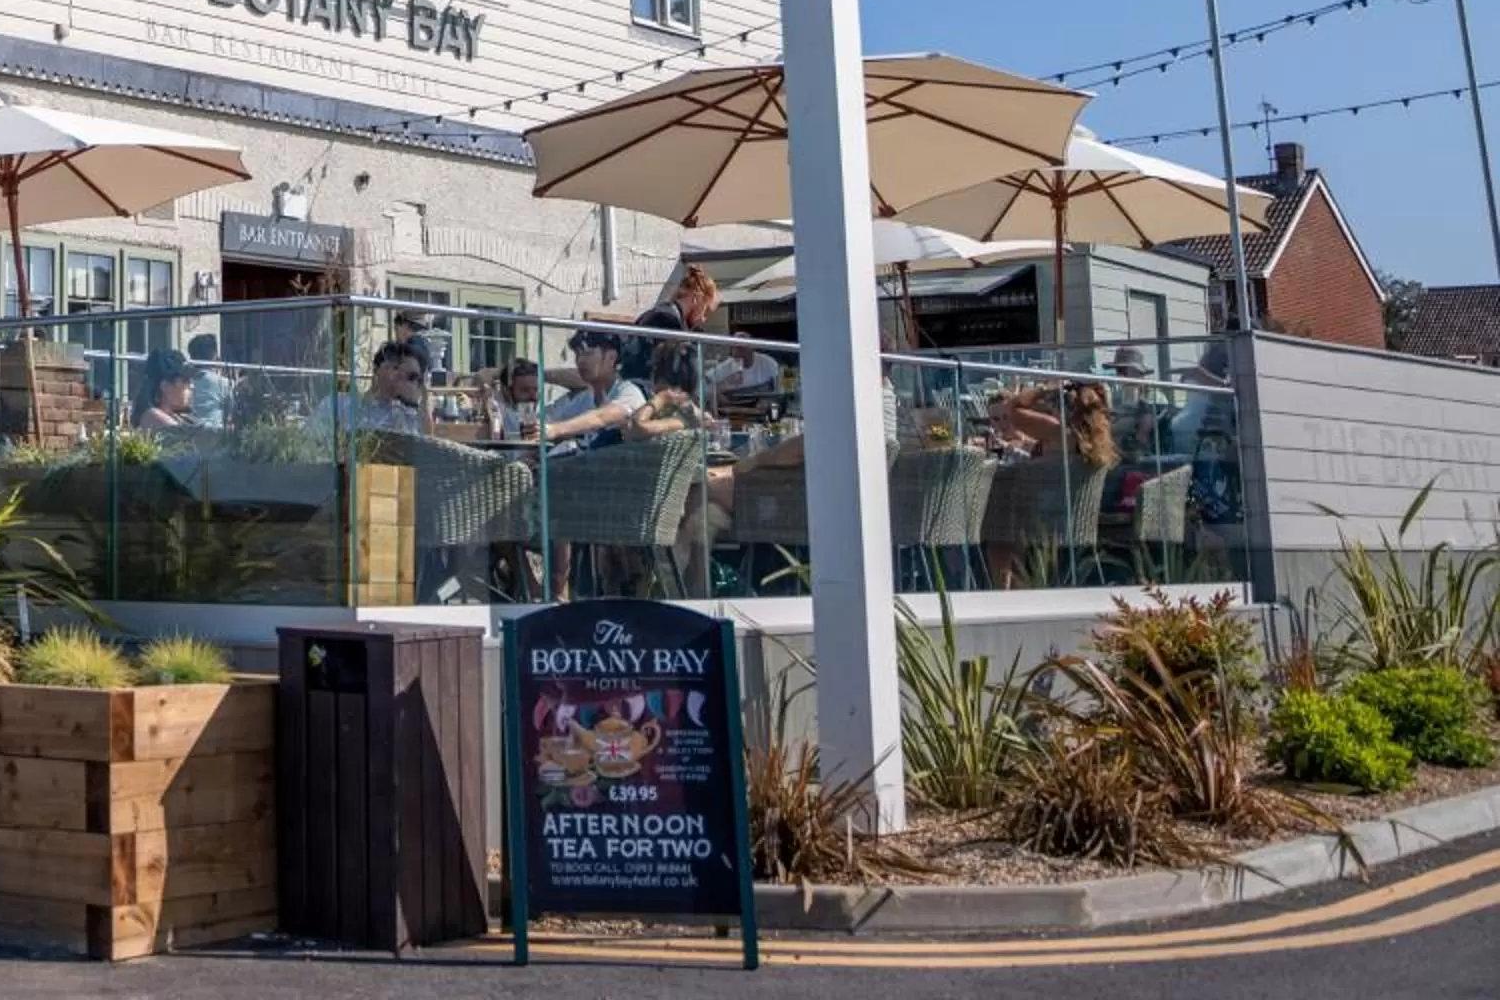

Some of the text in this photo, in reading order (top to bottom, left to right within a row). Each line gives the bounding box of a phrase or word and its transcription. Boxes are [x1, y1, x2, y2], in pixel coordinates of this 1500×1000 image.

[146, 17, 191, 47] BAR
[212, 32, 357, 81] RESTAURANT
[240, 223, 266, 244] BAR
[1302, 421, 1370, 483] THE
[593, 619, 633, 645] The
[531, 648, 710, 674] BOTANY BAY
[585, 679, 642, 690] HOTEL
[543, 813, 705, 836] AFTERNOON
[547, 837, 712, 859] TEA FOR TWO
